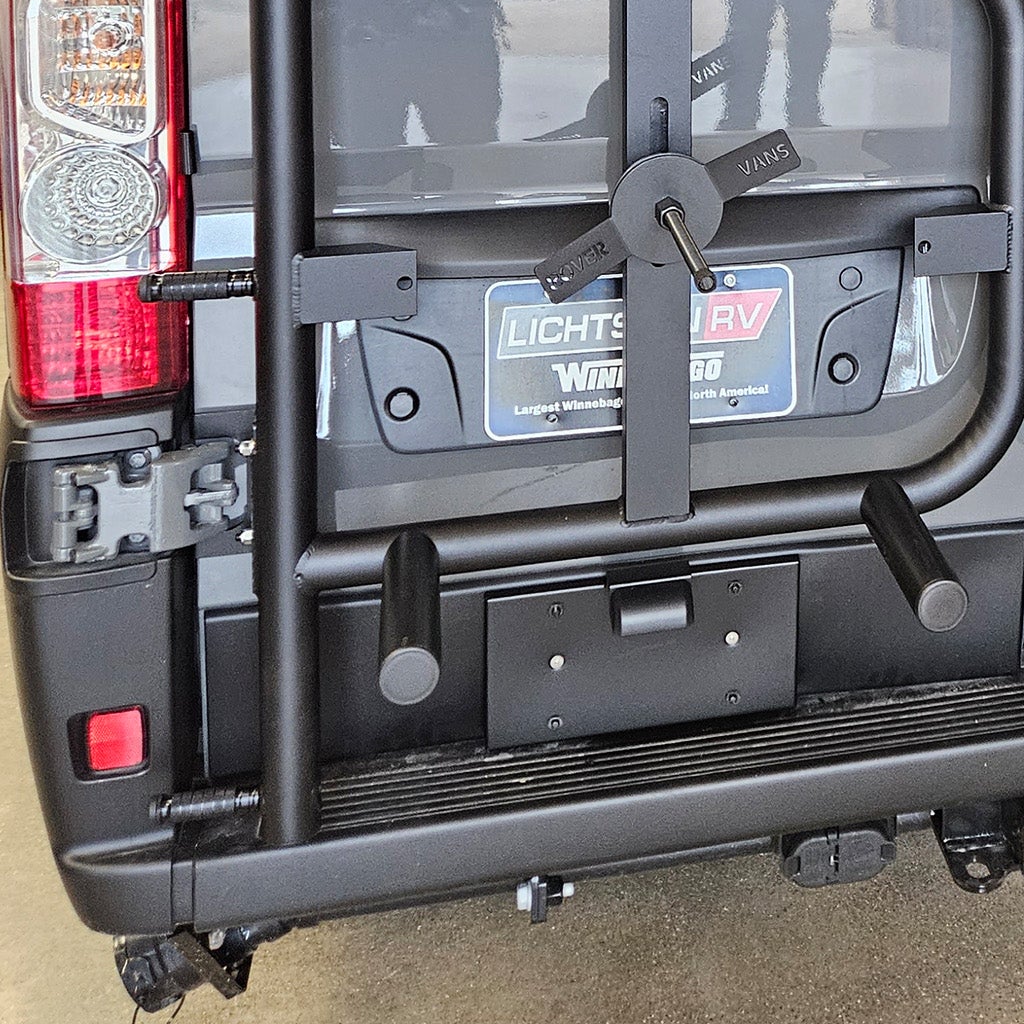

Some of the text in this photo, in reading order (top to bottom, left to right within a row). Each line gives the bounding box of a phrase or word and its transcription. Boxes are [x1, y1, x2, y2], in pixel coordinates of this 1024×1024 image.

[736, 143, 790, 176] VANS
[544, 240, 611, 291] ROVER
[710, 302, 765, 333] RV
[513, 401, 560, 416] Largest
[562, 396, 623, 412] Winnebag
[718, 383, 770, 398] America!
